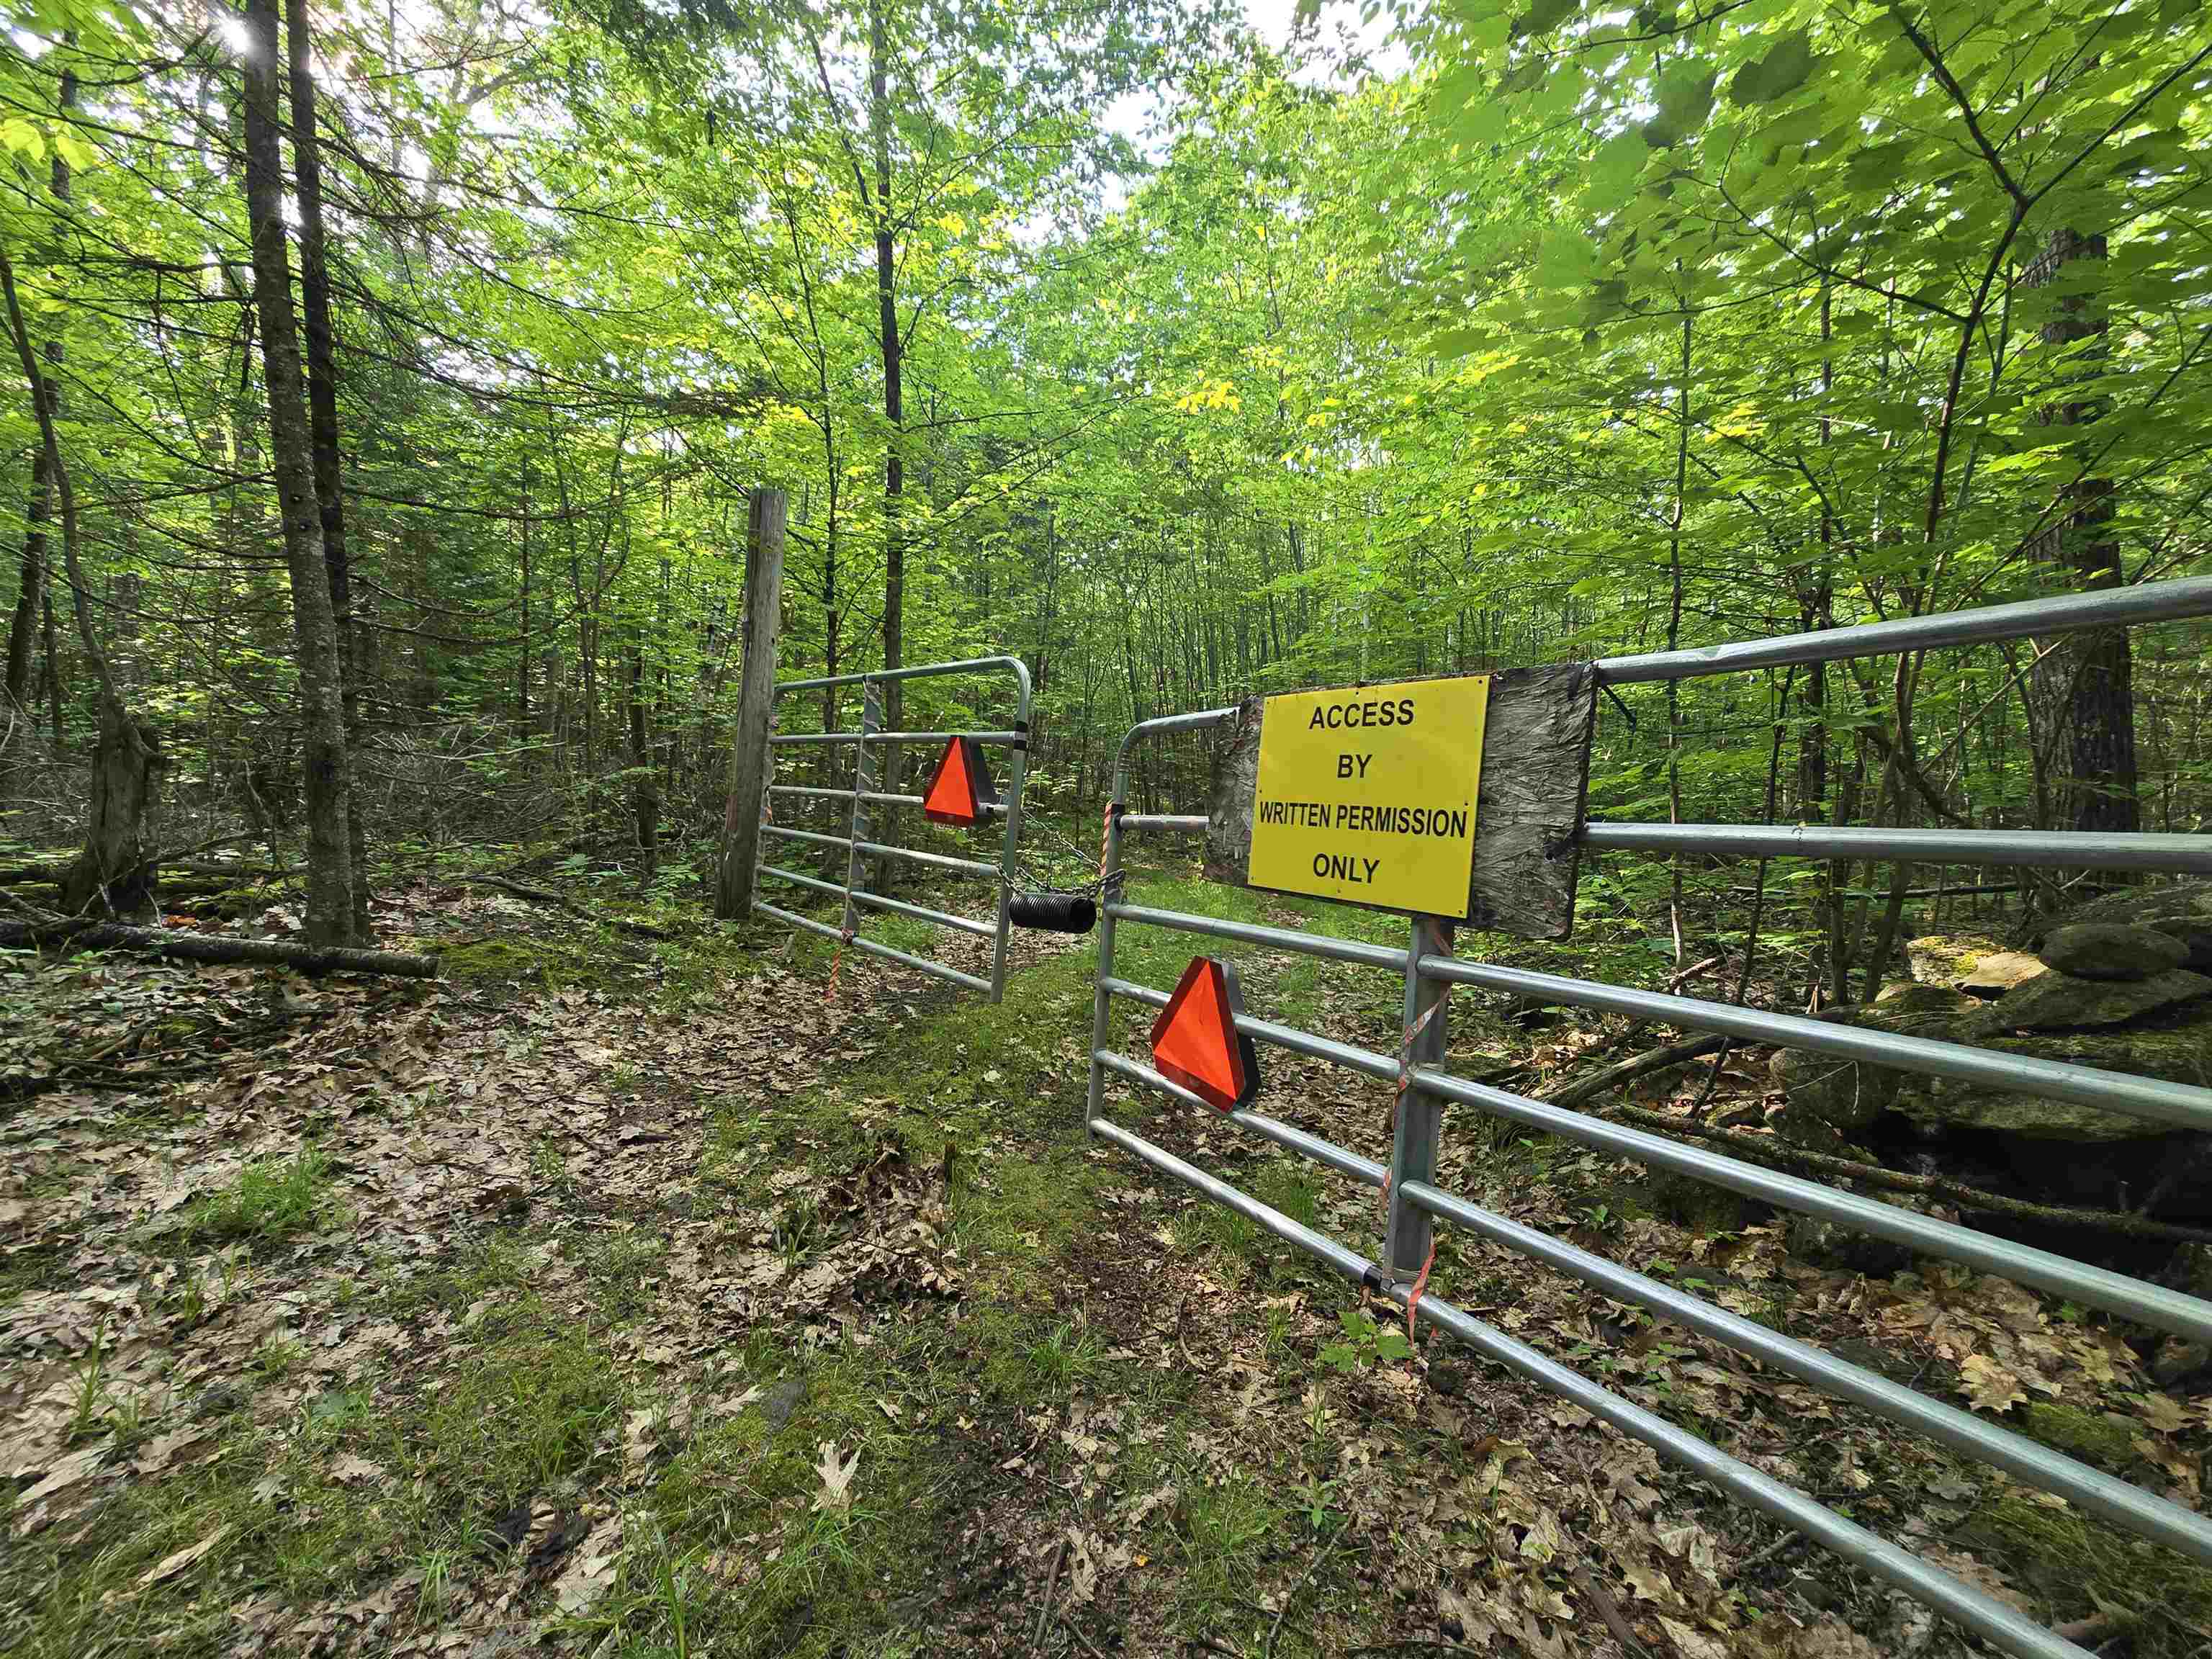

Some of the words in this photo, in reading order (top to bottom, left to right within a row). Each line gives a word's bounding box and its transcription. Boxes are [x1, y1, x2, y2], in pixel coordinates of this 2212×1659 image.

[1308, 699, 1414, 729] ACCESS
[1337, 754, 1372, 778] BY
[1259, 801, 1331, 828] WRITTEN
[1336, 804, 1468, 837] PERMISSION
[1313, 853, 1380, 884] ONLY
